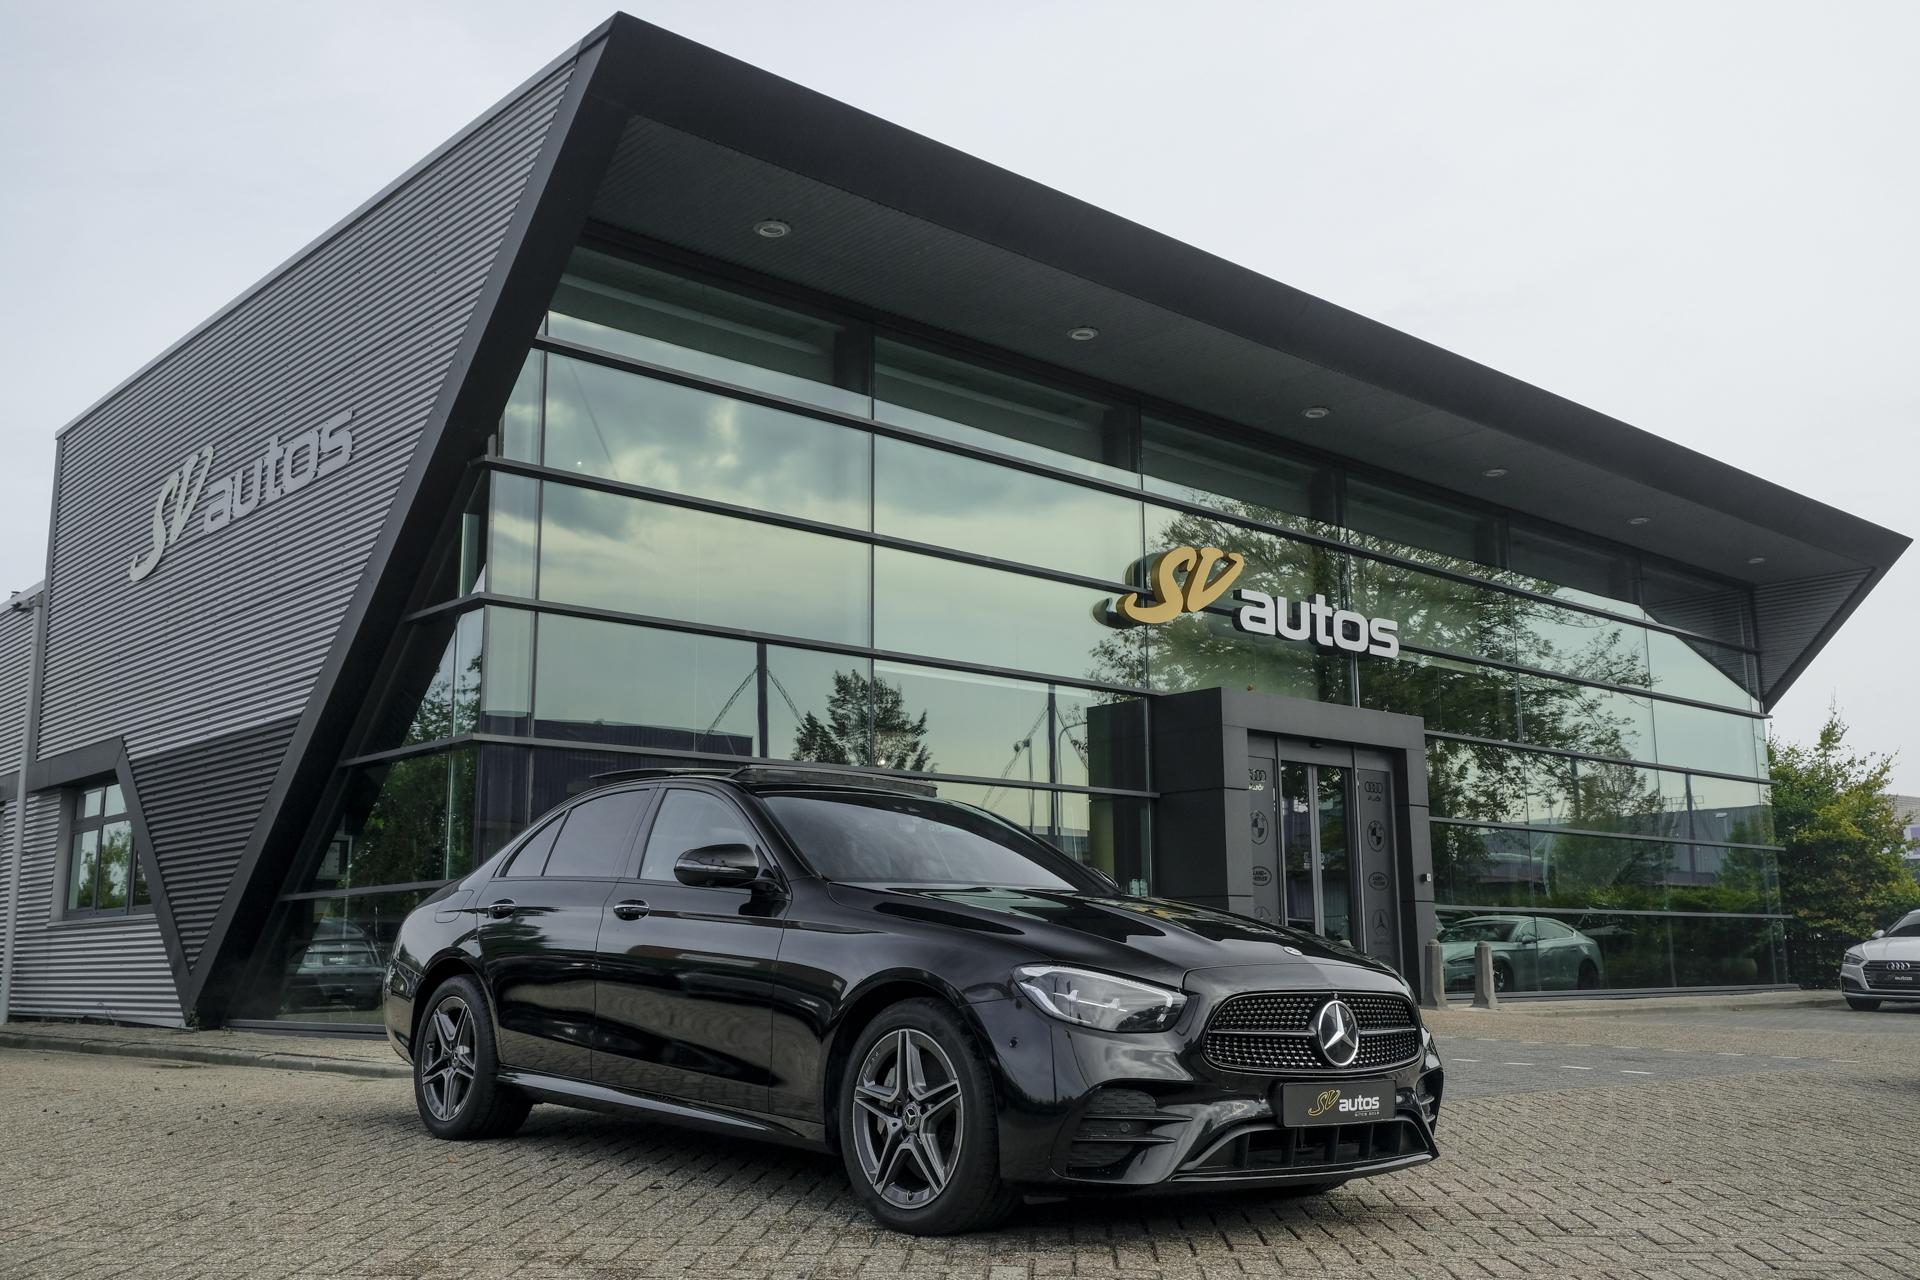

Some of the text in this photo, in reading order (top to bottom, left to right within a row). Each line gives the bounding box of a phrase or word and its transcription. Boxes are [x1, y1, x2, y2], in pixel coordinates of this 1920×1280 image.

[129, 407, 353, 582] SV autos
[1117, 546, 1400, 658] SV autos
[1308, 1089, 1380, 1116] SV autos
